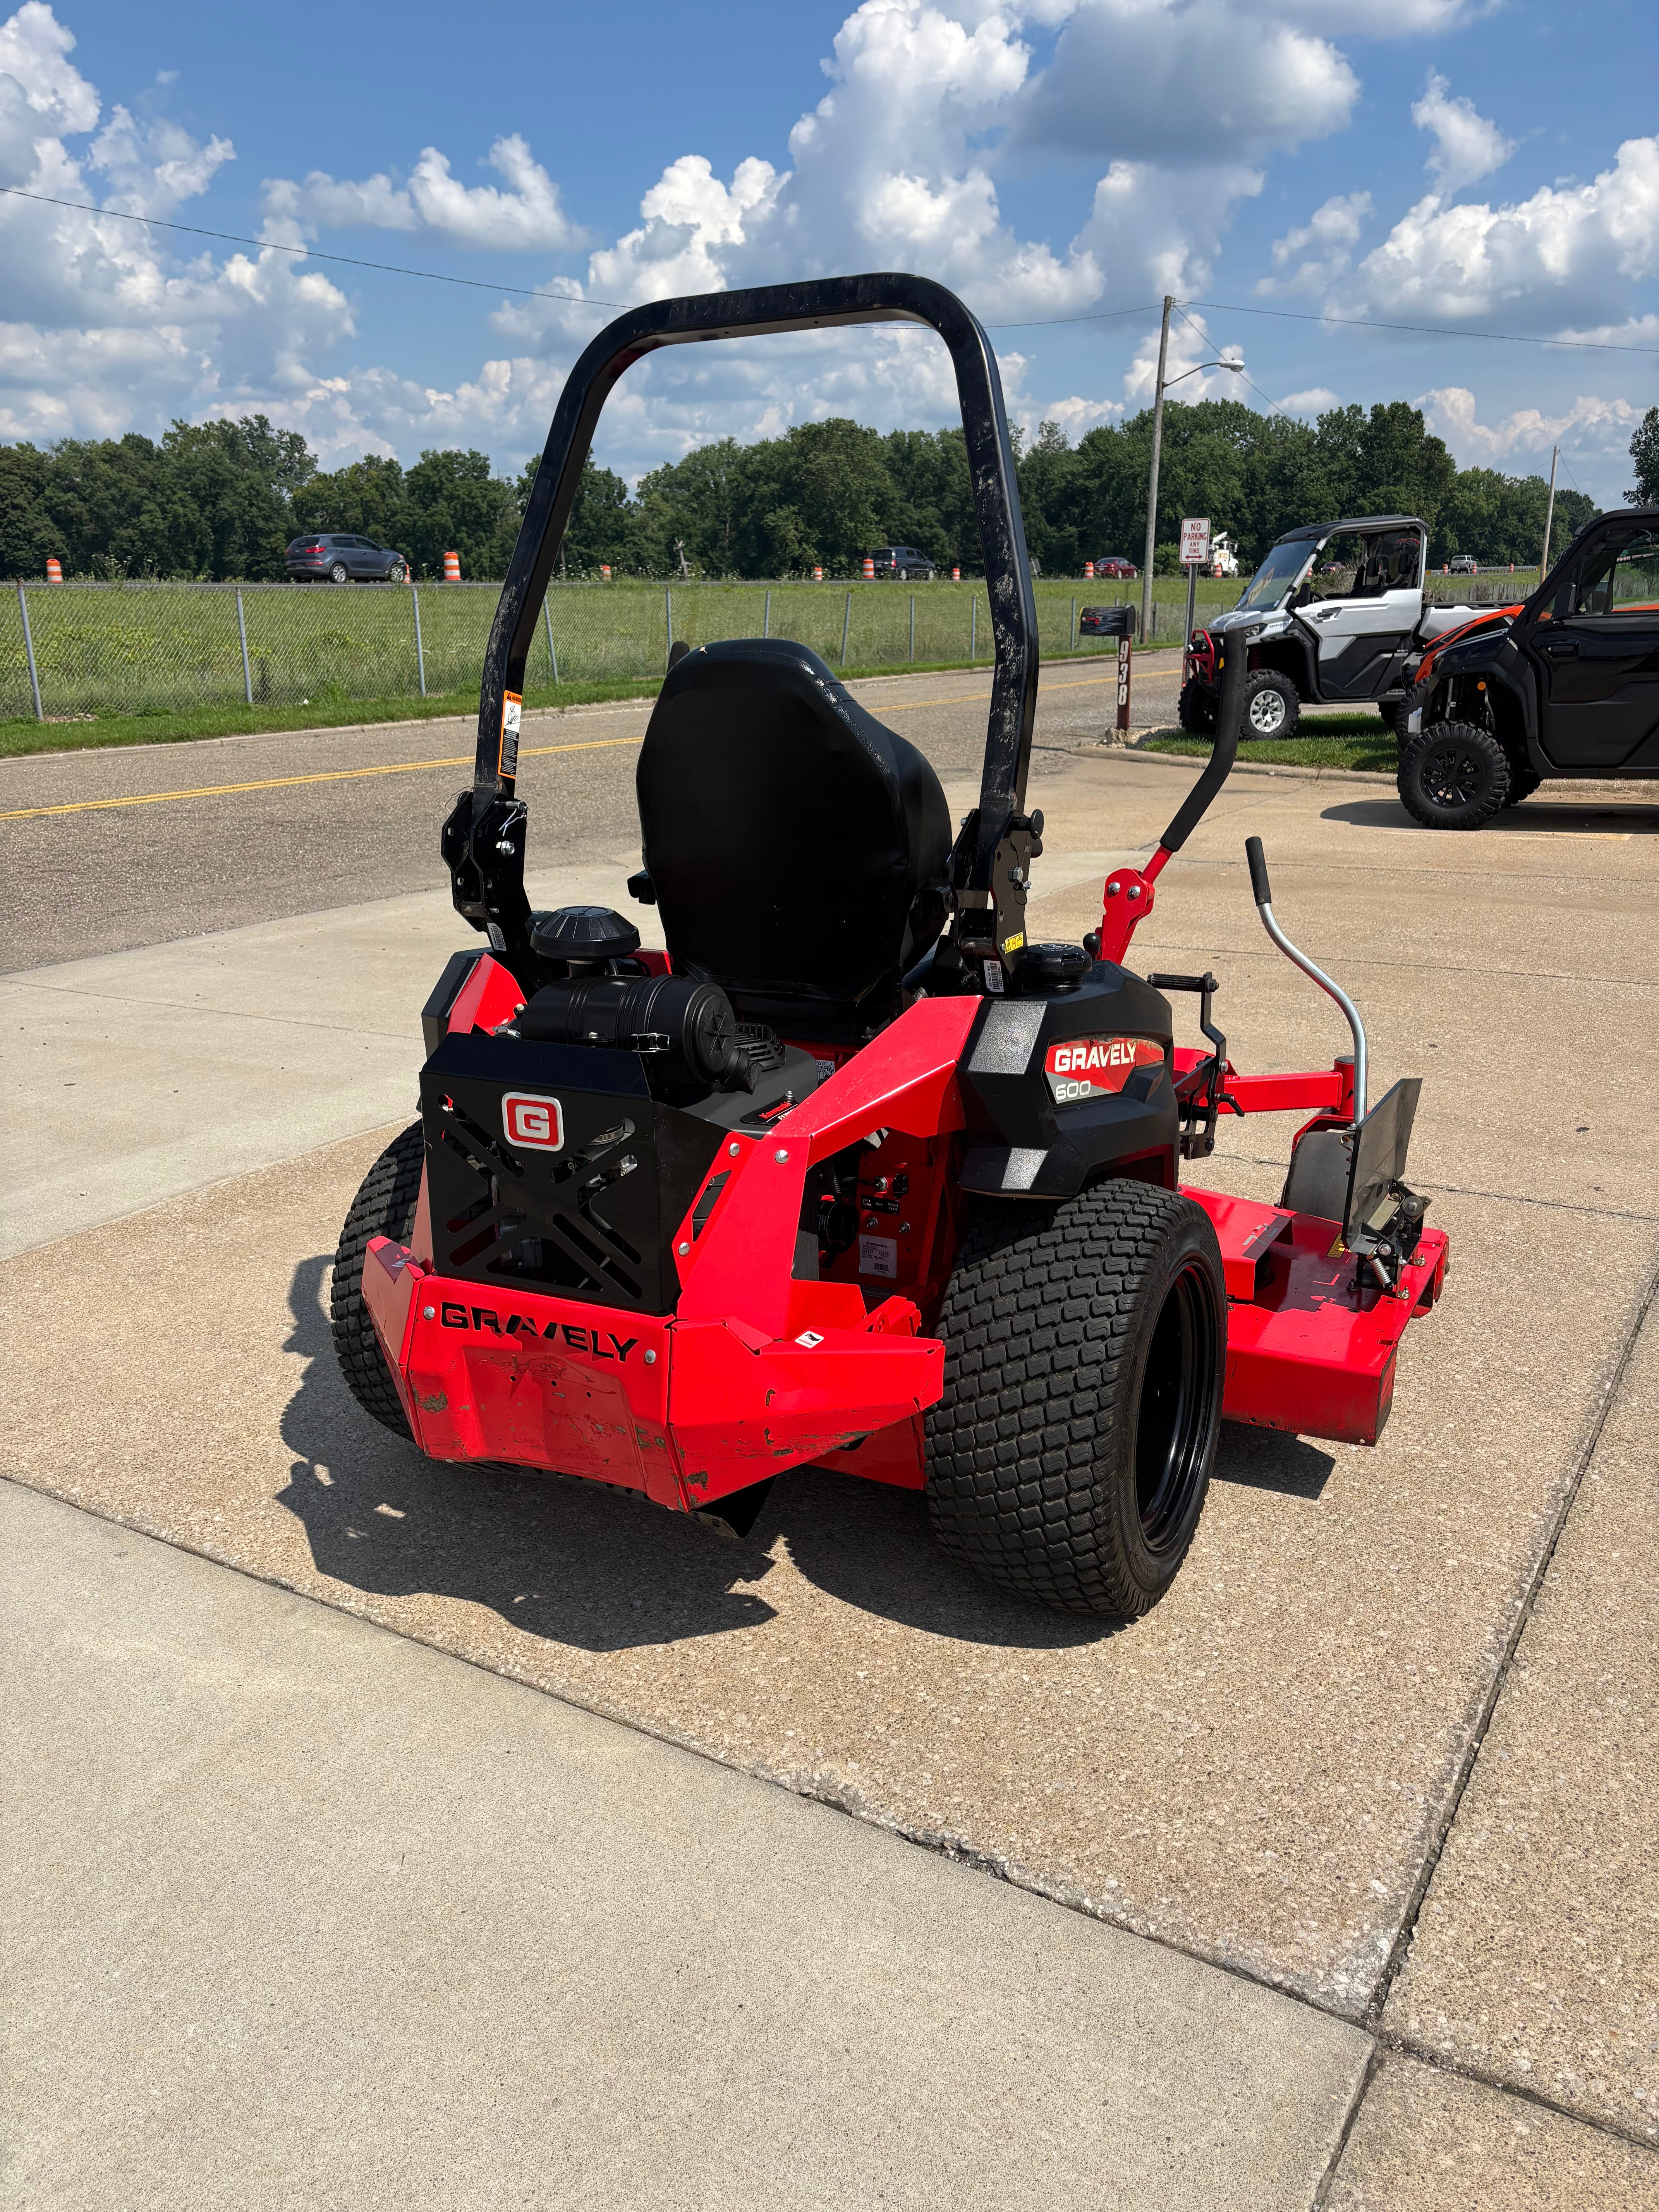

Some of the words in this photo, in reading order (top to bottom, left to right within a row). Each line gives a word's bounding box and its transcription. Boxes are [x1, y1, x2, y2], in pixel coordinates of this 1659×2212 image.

[1183, 532, 1207, 541] PARKING
[1191, 523, 1200, 531] NO
[1118, 641, 1129, 705] 938
[1054, 1042, 1136, 1072] GRAVELY
[1056, 1080, 1091, 1101] 600
[759, 1101, 792, 1119] Kawasaki
[441, 1301, 639, 1362] GRAVELY
